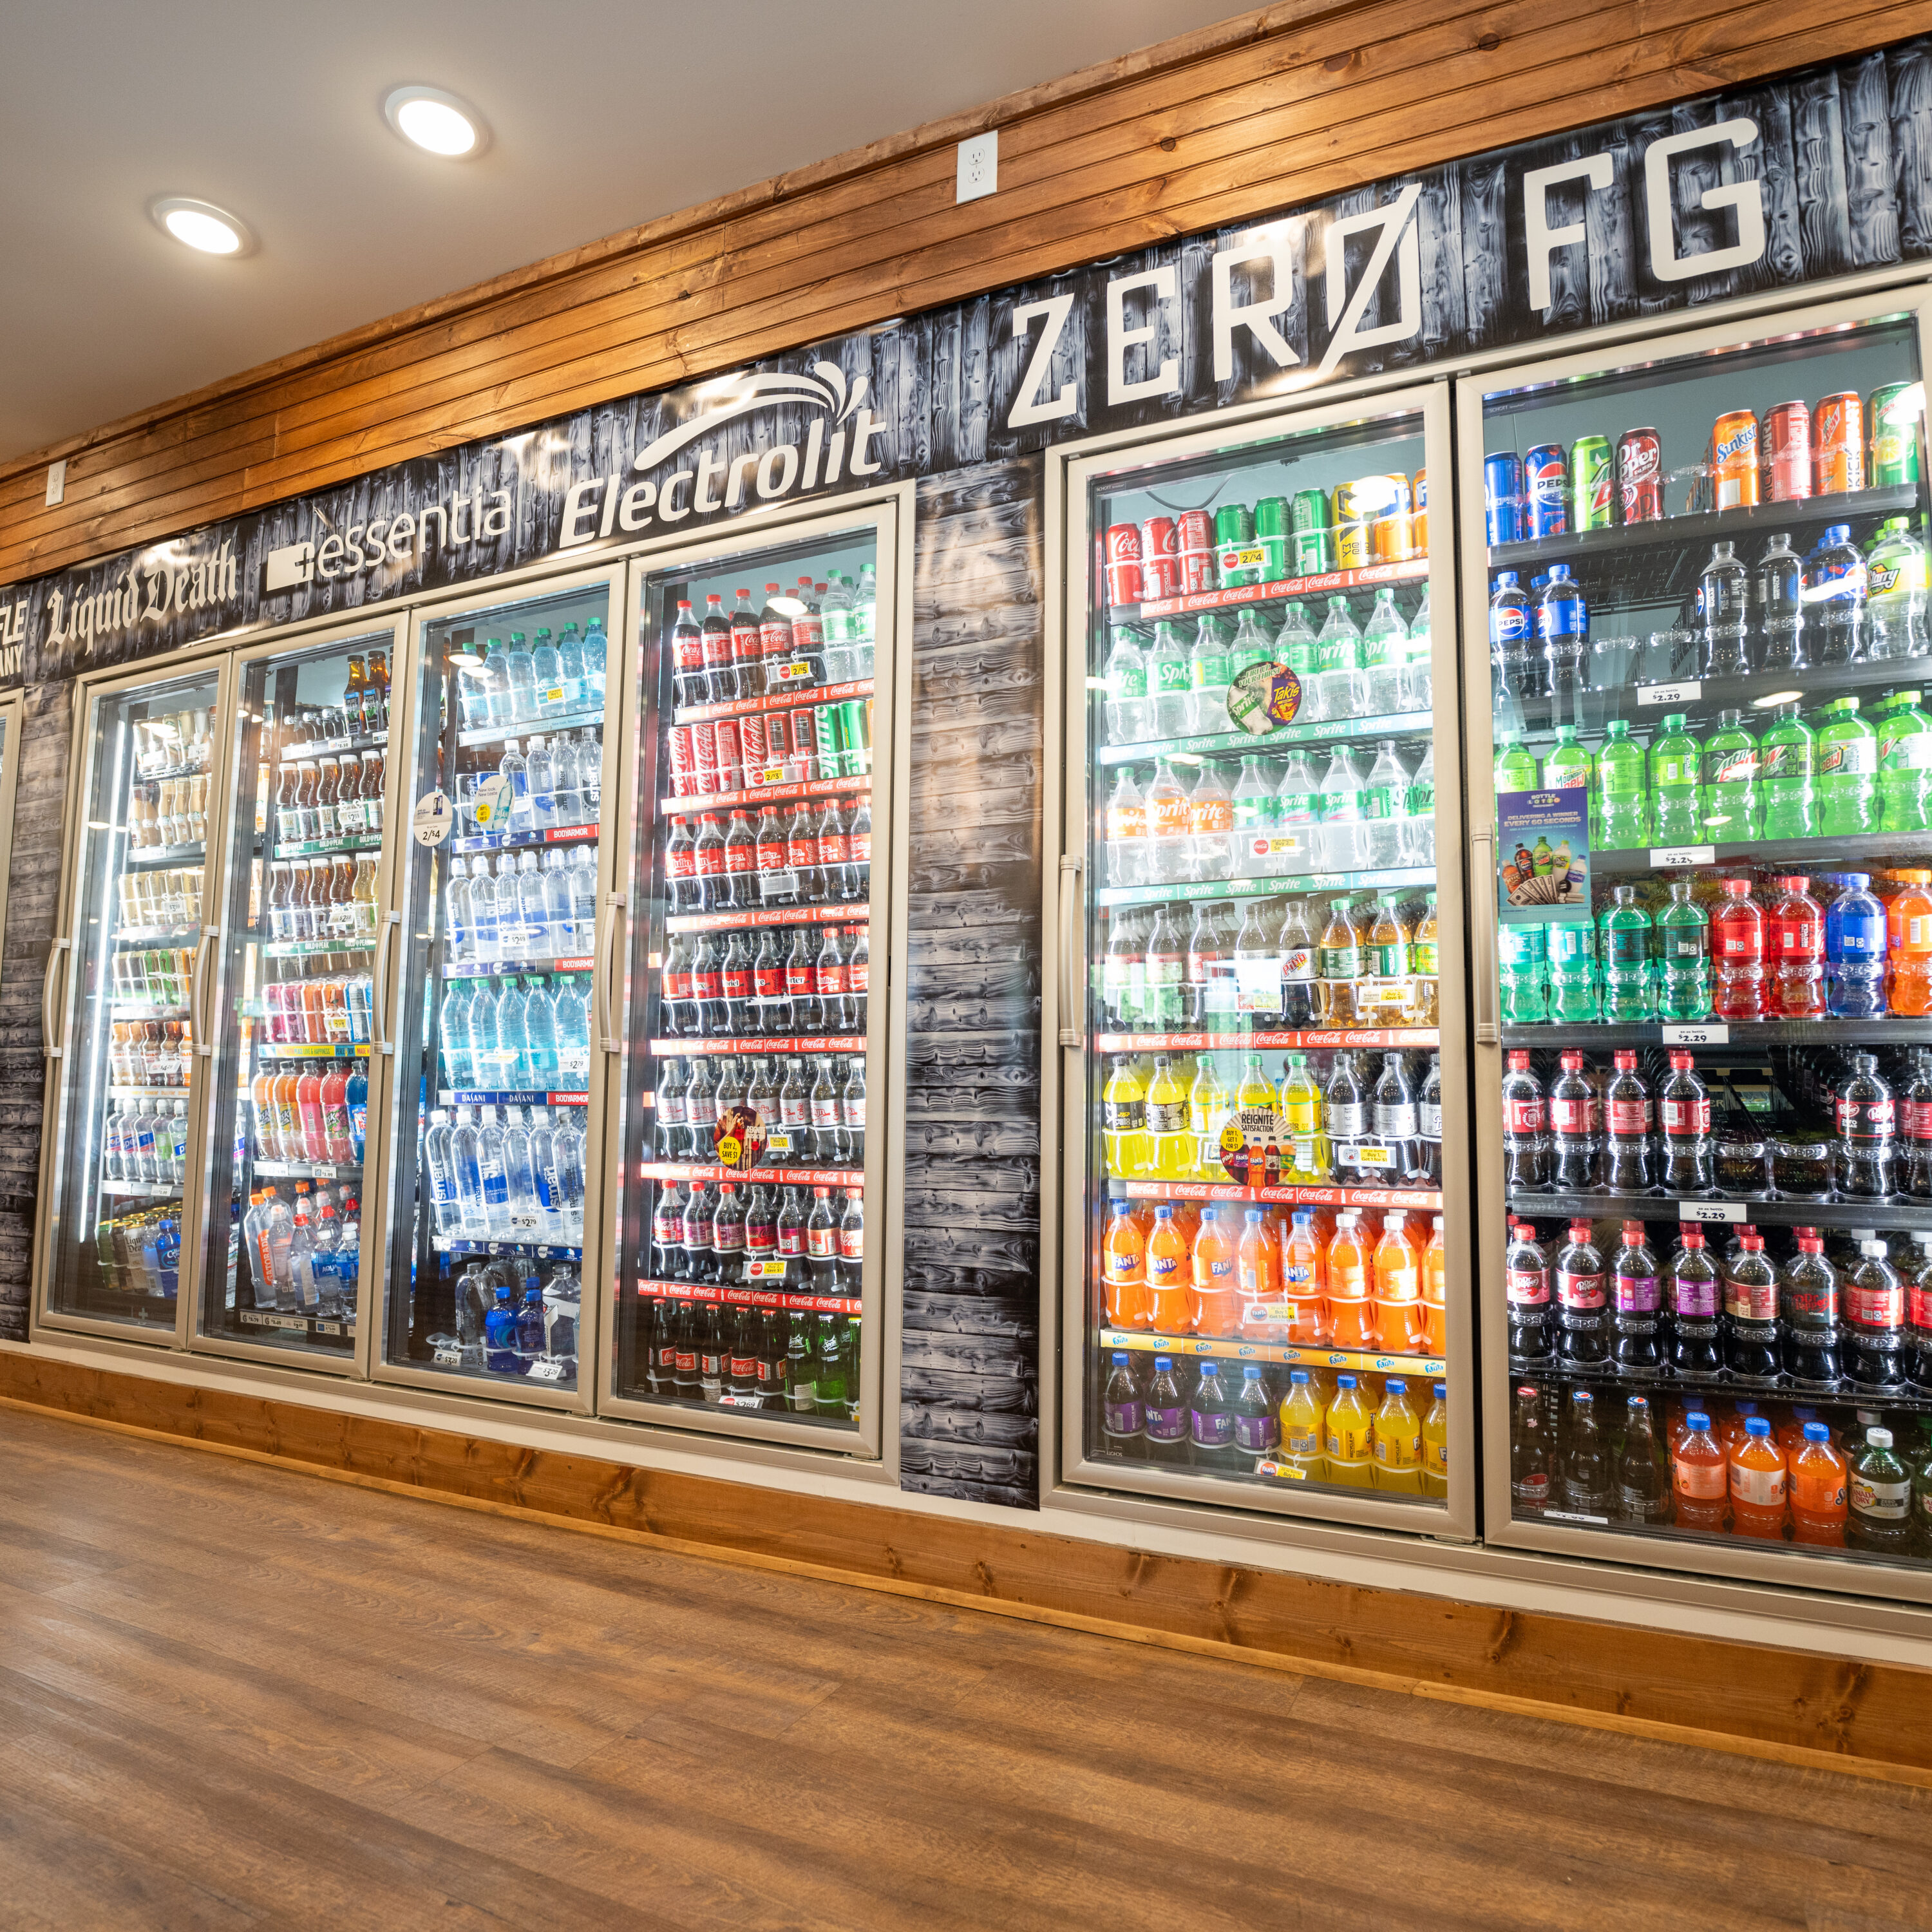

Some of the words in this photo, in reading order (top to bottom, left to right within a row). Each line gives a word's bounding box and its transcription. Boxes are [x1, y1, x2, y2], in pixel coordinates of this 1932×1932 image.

[1619, 439, 1641, 463] Dr
[1717, 424, 1757, 464] Sunkist
[1619, 448, 1657, 481] pper
[559, 407, 888, 549] Electrolit
[317, 486, 511, 578] essentia
[1271, 580, 1303, 594] Coca-Cola
[1308, 574, 1341, 589] Coca-Cola
[45, 567, 140, 656] Liquid
[140, 538, 237, 623] Death
[1499, 618, 1524, 627] PEPSI
[736, 699, 758, 710] Coca-Cola
[770, 693, 792, 705] Coca-Cola
[795, 688, 819, 701] Coca-Cola
[831, 683, 855, 696] Coca-Cola
[1232, 690, 1256, 715] Sprite
[1273, 681, 1300, 703] Takis
[1145, 743, 1175, 756] Sprite
[1187, 737, 1216, 751] Sprite
[1227, 733, 1258, 747] Sprite
[1313, 723, 1347, 737] Sprite
[1358, 718, 1392, 732] Sprite
[750, 787, 772, 799] Coca-Cola
[775, 784, 798, 795] Coca-Cola
[810, 779, 833, 792] Coca-Cola
[837, 775, 861, 789] Coca-Cola
[1280, 795, 1309, 807] Sprite
[1544, 816, 1582, 824] SECONDS
[422, 829, 440, 841] 2/$4
[554, 828, 588, 838] BODYARMOR
[1143, 887, 1173, 900] Sprite
[1184, 884, 1214, 897] Sprite
[1269, 878, 1300, 892] Sprite
[1358, 872, 1392, 885] Sprite
[759, 911, 781, 922] Coca-Cola
[784, 908, 808, 920] Coca-Cola
[706, 1039, 729, 1050] Coca-Cola
[741, 1039, 763, 1050] Coca-Cola
[766, 1039, 790, 1050] Coca-Cola
[802, 1039, 825, 1049] Coca-Cola
[829, 1038, 853, 1048] Coca-Cola
[1256, 1032, 1289, 1045] Coca-Cola
[1307, 1032, 1341, 1045] Coca-Cola
[1345, 1030, 1381, 1044] Coca-Cola
[1678, 1034, 1707, 1043] $2.29
[746, 1126, 765, 1134] REIGNITE
[1241, 1114, 1274, 1126] REIGNITE
[692, 1168, 714, 1178] Coca-Cola
[752, 1169, 774, 1179] Coca-Cola
[787, 1171, 811, 1181] Coca-Cola
[813, 1171, 838, 1182] Coca-Cola
[546, 1166, 559, 1207] smart
[1175, 1184, 1206, 1197] Coca-Cola
[1211, 1185, 1243, 1198] Coca-Cola
[1260, 1187, 1293, 1200] Coca-Cola
[1299, 1189, 1333, 1202] Coca-Cola
[1352, 1191, 1387, 1204] Coca-Cola
[1392, 1193, 1428, 1206] Coca-Cola
[1696, 1211, 1725, 1219] $2.29
[261, 1236, 272, 1283] GATORADE
[1113, 1253, 1141, 1269] FANTA
[669, 1285, 691, 1296] Coca-Cola
[694, 1287, 715, 1298] Coca-Cola
[728, 1291, 751, 1302] Coca-Cola
[754, 1292, 777, 1303] Coca-Cola
[790, 1295, 813, 1307] Coca-Cola
[817, 1297, 841, 1309] Coca-Cola
[1113, 1336, 1128, 1346] Fanta
[1153, 1340, 1169, 1349] Fanta
[1196, 1343, 1212, 1353] Fanta
[1239, 1347, 1256, 1358] Fanta
[1283, 1350, 1301, 1361] Fanta
[1329, 1355, 1347, 1365] Fanta
[1376, 1358, 1395, 1369] Fanta
[1425, 1363, 1444, 1374] Fanta
